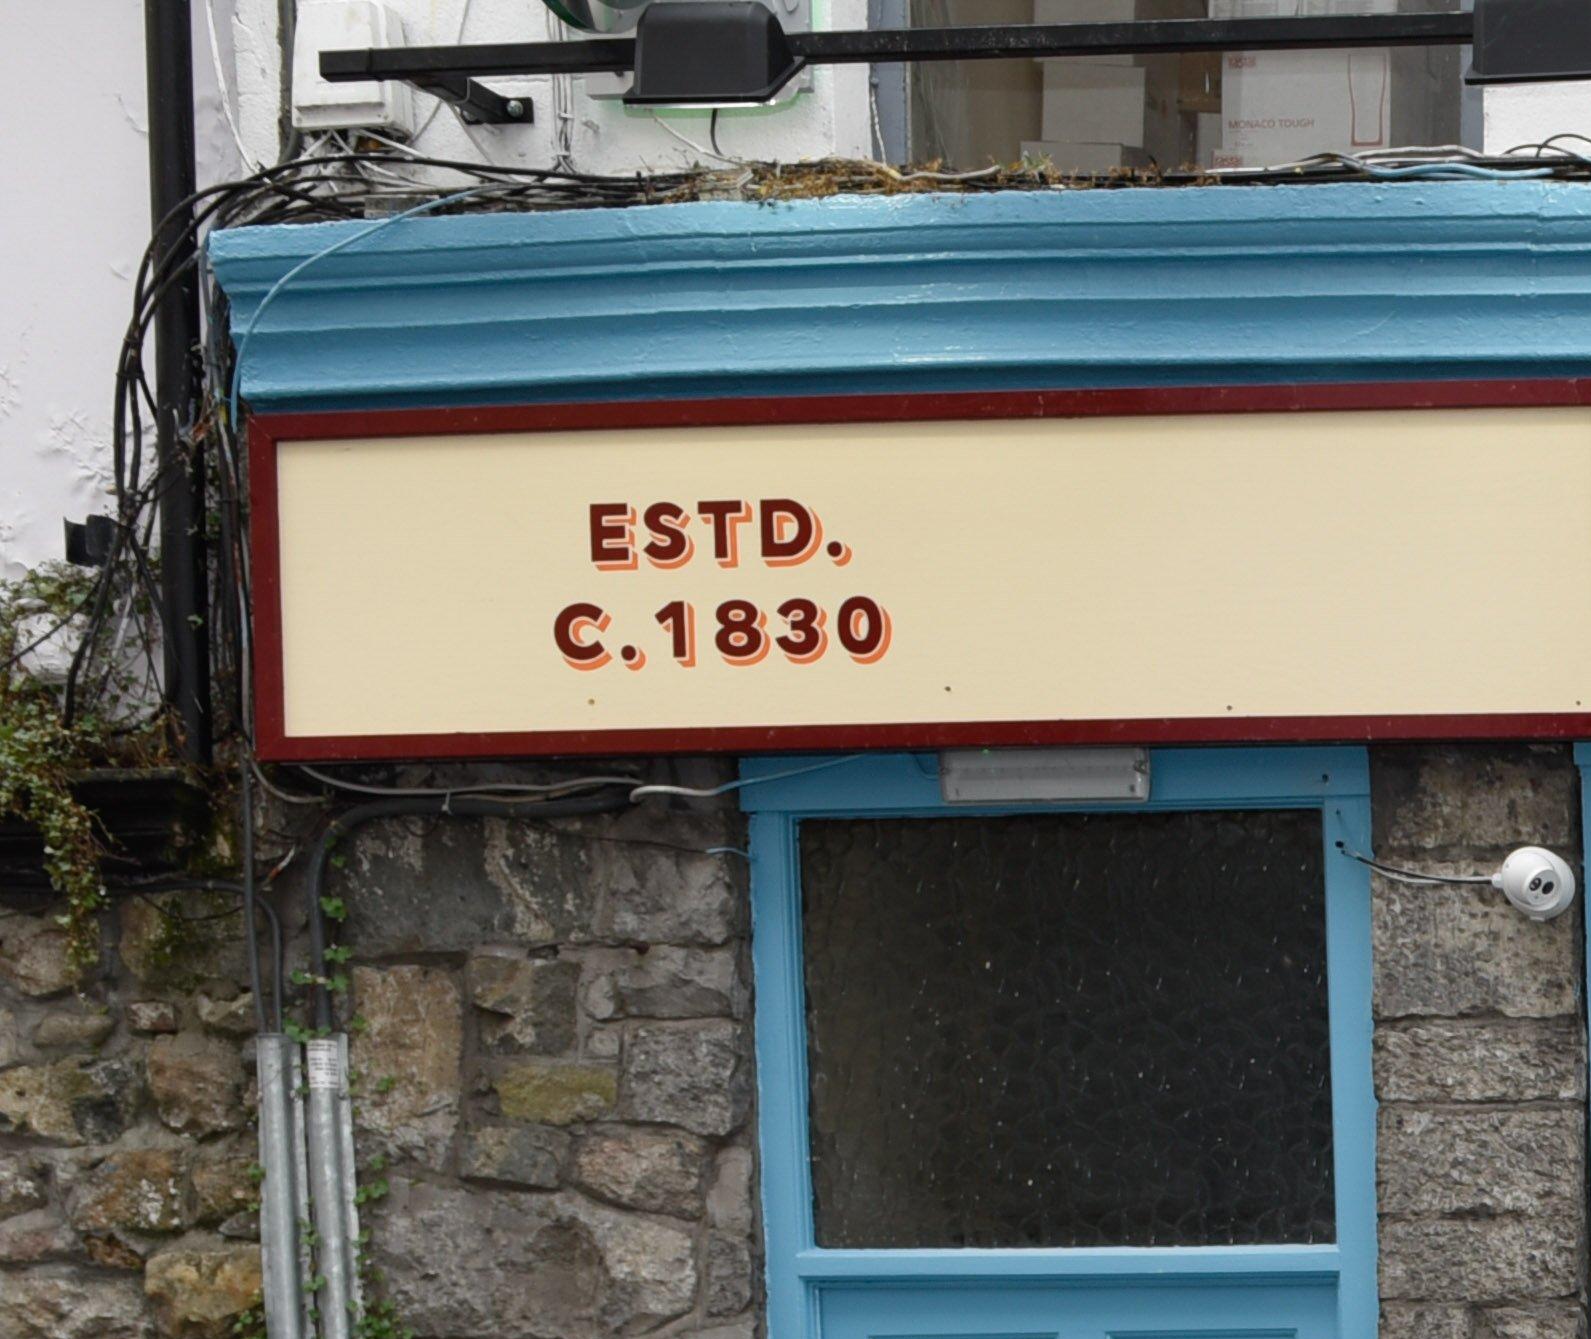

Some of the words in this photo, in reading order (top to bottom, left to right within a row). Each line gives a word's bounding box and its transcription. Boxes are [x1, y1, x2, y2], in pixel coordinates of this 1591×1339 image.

[1228, 119, 1276, 129] MONACO
[1279, 118, 1315, 128] TOUGH
[589, 498, 852, 571] ESTD.
[553, 595, 892, 671] C.1830
